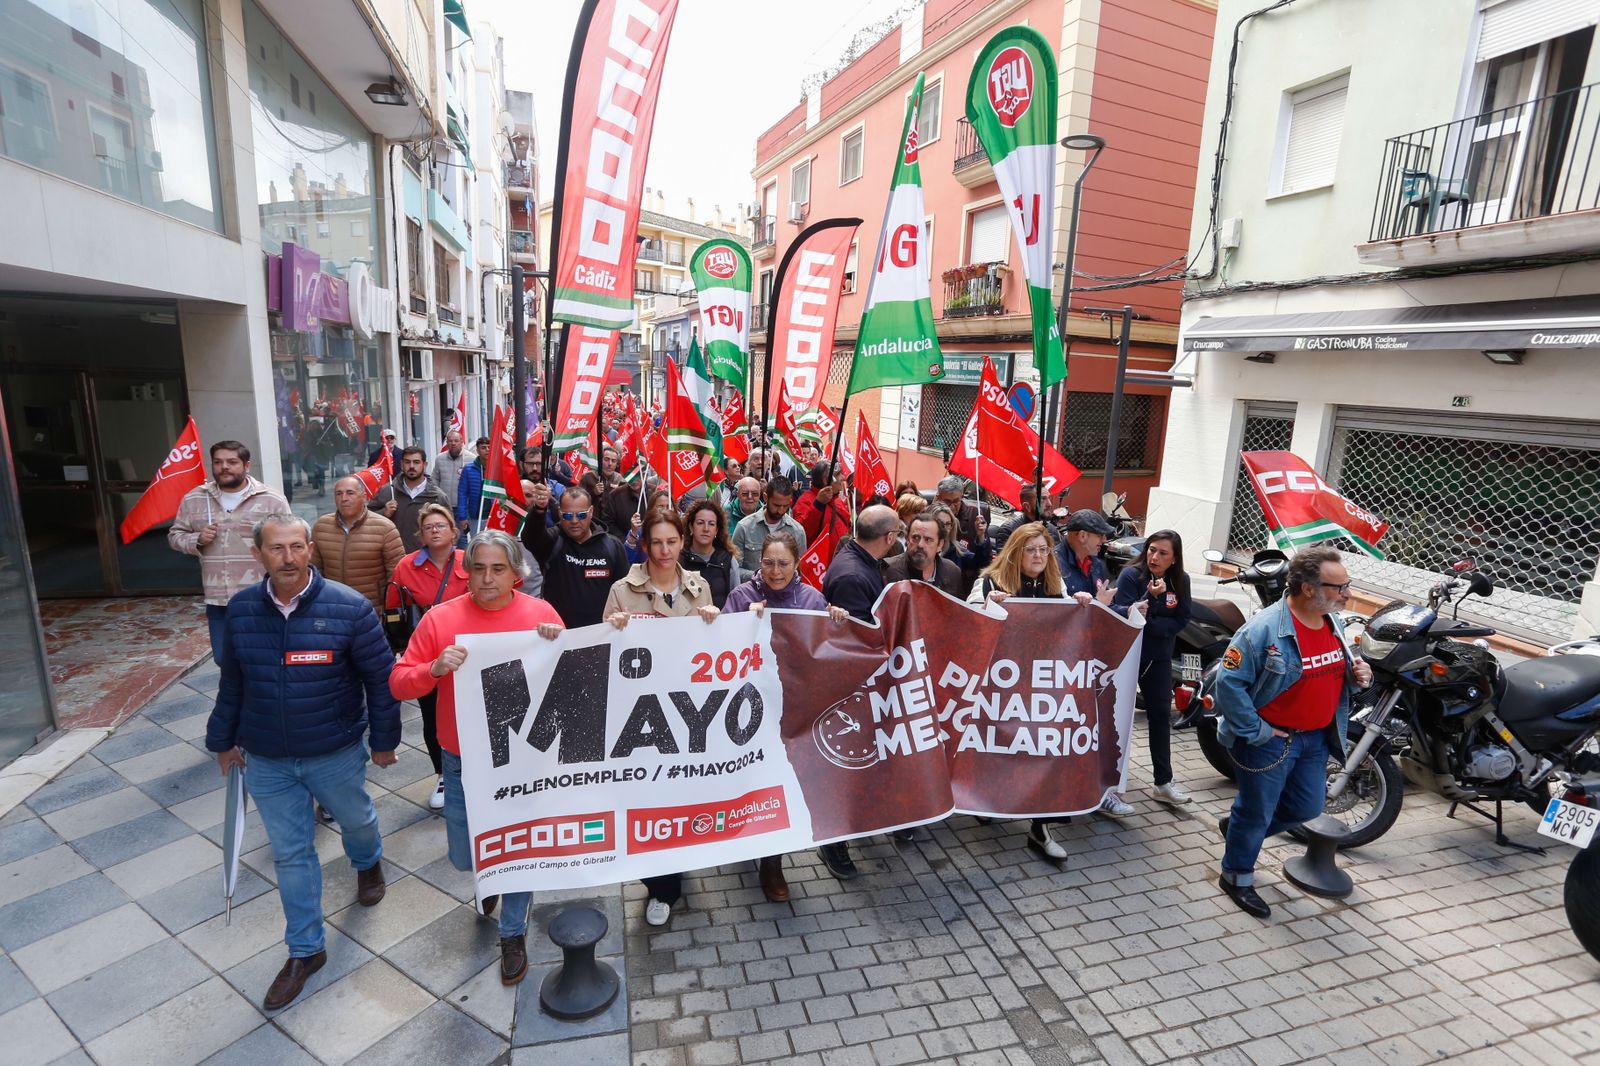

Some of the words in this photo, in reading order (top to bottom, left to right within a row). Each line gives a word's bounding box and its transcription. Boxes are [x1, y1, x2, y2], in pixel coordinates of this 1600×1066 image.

[575, 264, 617, 291] Cádiz
[567, 417, 589, 430] Cádiz
[585, 558, 607, 566] JEANS
[493, 766, 648, 801] #PLENOEMPLEO
[666, 748, 765, 780] #1MAYO2024
[728, 796, 781, 820] Andalucía
[1557, 804, 1594, 827] 2905
[634, 817, 689, 842] UGT
[728, 819, 745, 829] Campo
[753, 812, 777, 822] Gibraltar
[1550, 819, 1580, 840] MCW
[480, 821, 580, 862] CCOO
[498, 862, 537, 874] comarcal
[539, 861, 568, 870] Campo
[570, 859, 581, 867] de
[583, 855, 617, 866] Gibraltar
